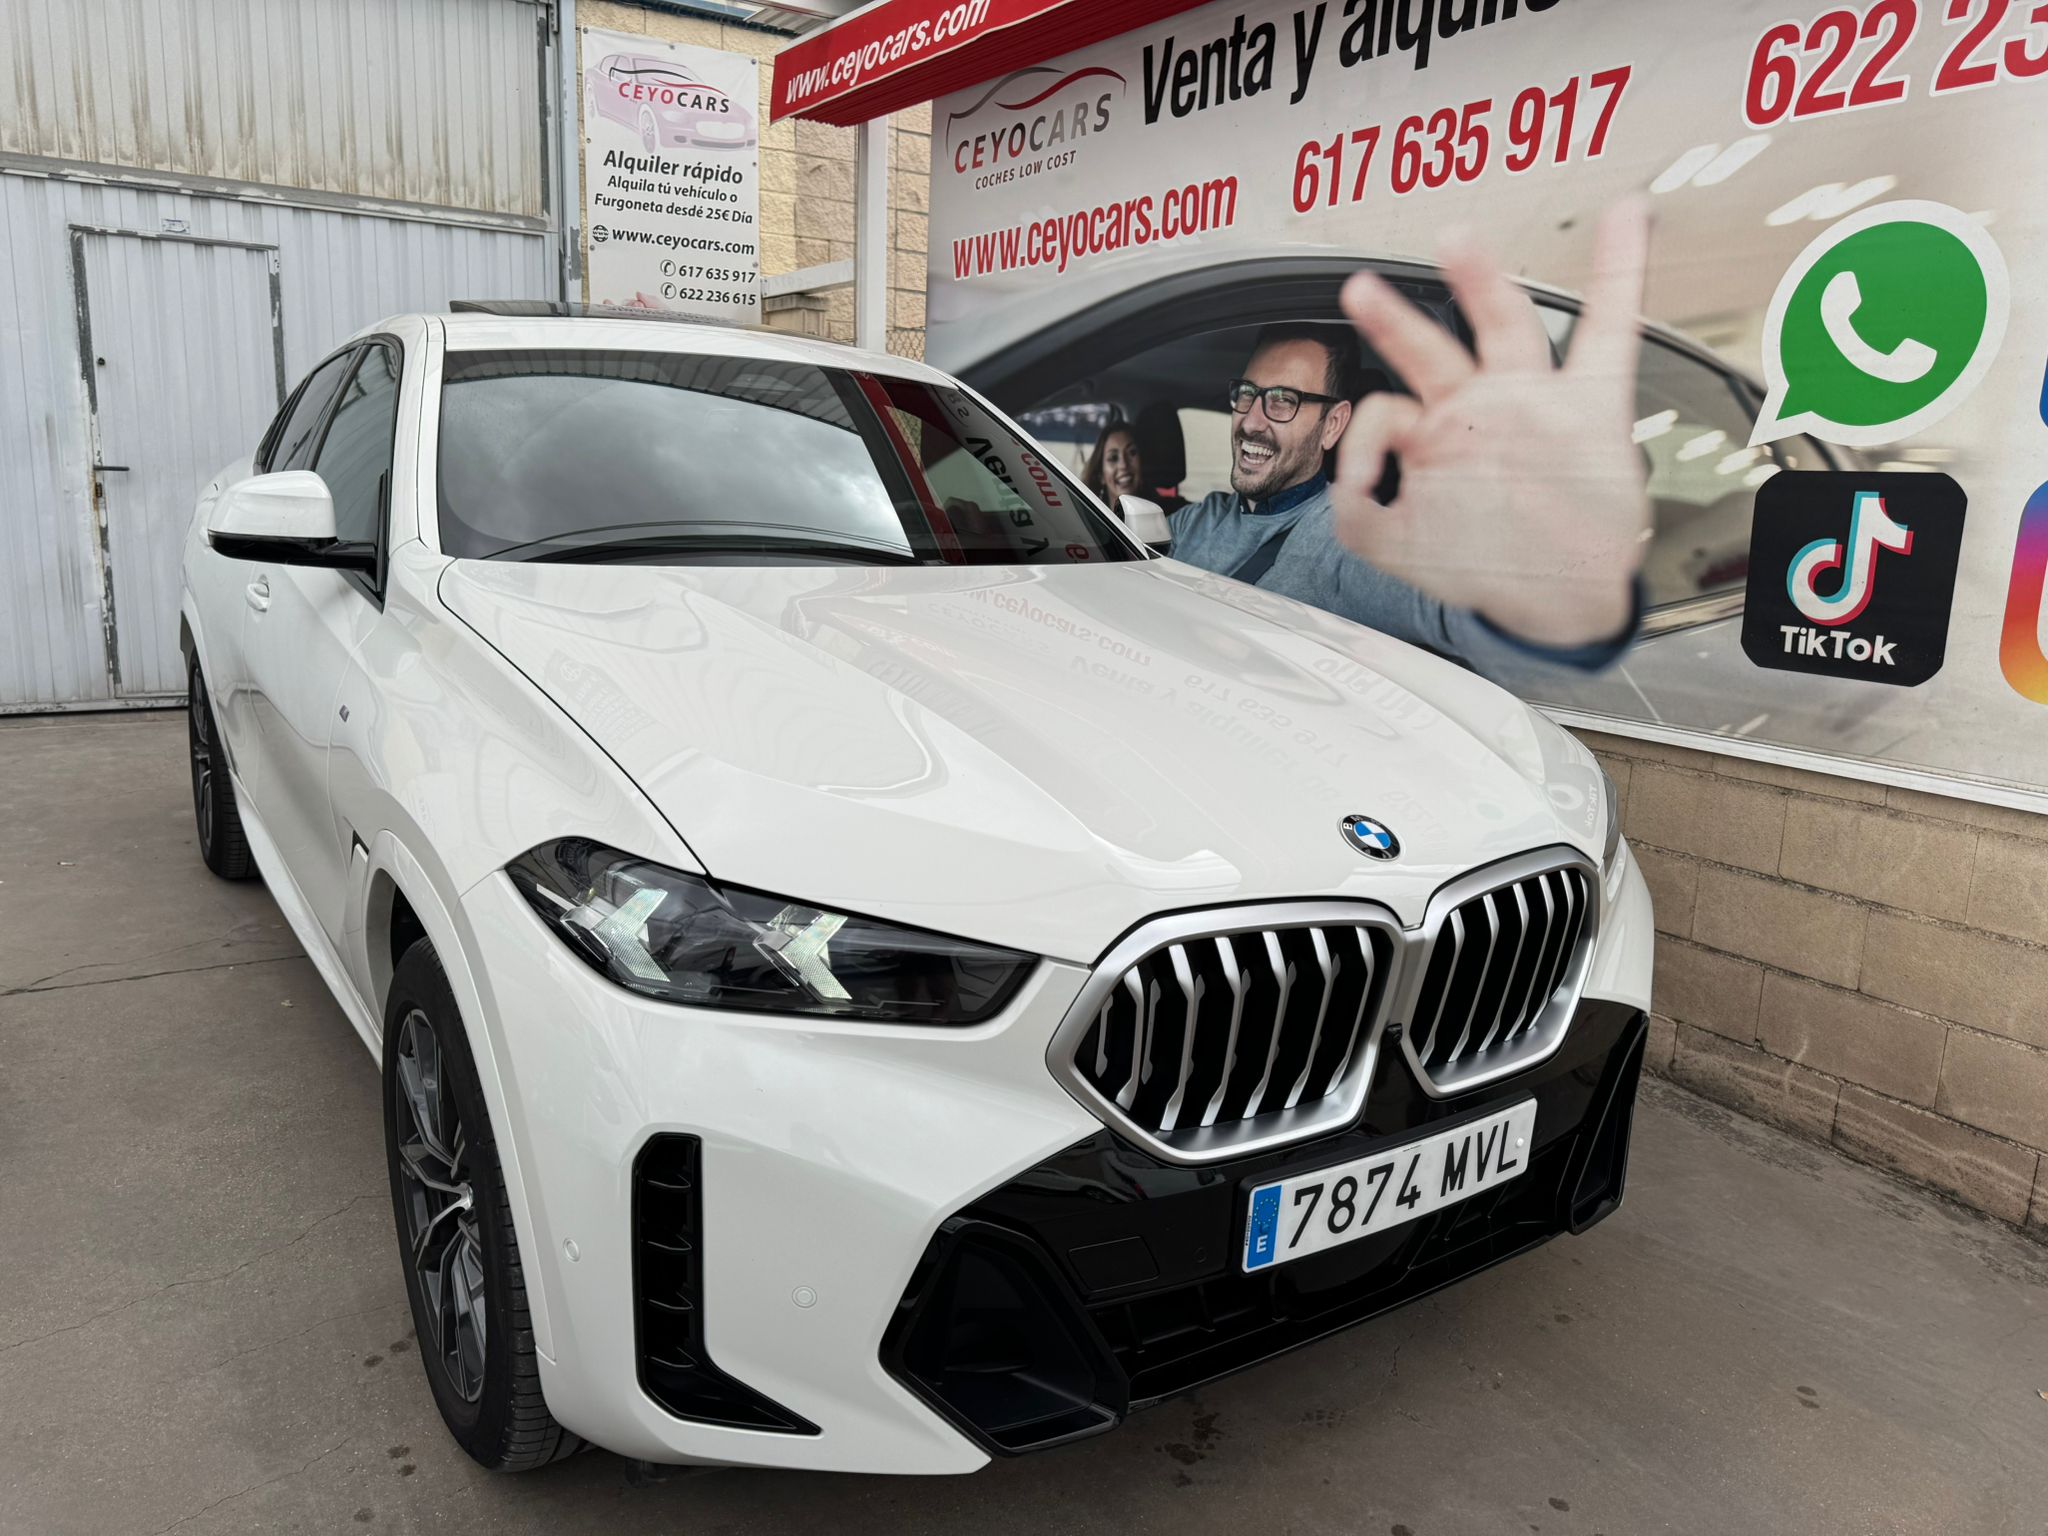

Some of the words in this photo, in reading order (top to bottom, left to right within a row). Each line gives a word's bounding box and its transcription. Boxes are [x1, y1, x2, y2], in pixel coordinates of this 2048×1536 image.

[785, 0, 991, 104] www.ceyocars.com
[1143, 15, 1277, 125] Venta
[1289, 3, 1327, 104] y
[1746, 0, 1917, 126] 622
[619, 82, 730, 113] CEYOCARS
[954, 93, 1111, 174] CEYOCARS
[1292, 126, 1381, 213] 617
[1391, 98, 1492, 195] 635
[1506, 65, 1632, 173] 917
[603, 150, 680, 176] Alquiler
[683, 162, 743, 185] rápido
[975, 167, 1015, 190] COCHES
[1019, 159, 1042, 179] LOW
[1047, 150, 1076, 170] COST
[594, 193, 663, 216] Furgoneta
[666, 199, 703, 218] desdé
[706, 207, 729, 222] 25€
[732, 209, 753, 224] Día
[608, 175, 655, 195] Alquila
[657, 180, 671, 195] tú
[674, 183, 726, 203] vehículo
[730, 193, 738, 203] o
[612, 228, 755, 256] www.ceyocars.com
[953, 175, 1237, 280] www.ceyocars.com
[679, 264, 703, 278] 617
[706, 266, 729, 281] 635
[732, 268, 755, 283] 917
[679, 287, 702, 301] 622
[705, 289, 729, 304] 236
[732, 290, 756, 306] 615
[1780, 625, 1897, 666] TikTok
[1256, 1234, 1268, 1253] E
[1289, 1154, 1421, 1248] 7874
[1440, 1120, 1517, 1197] MVL
